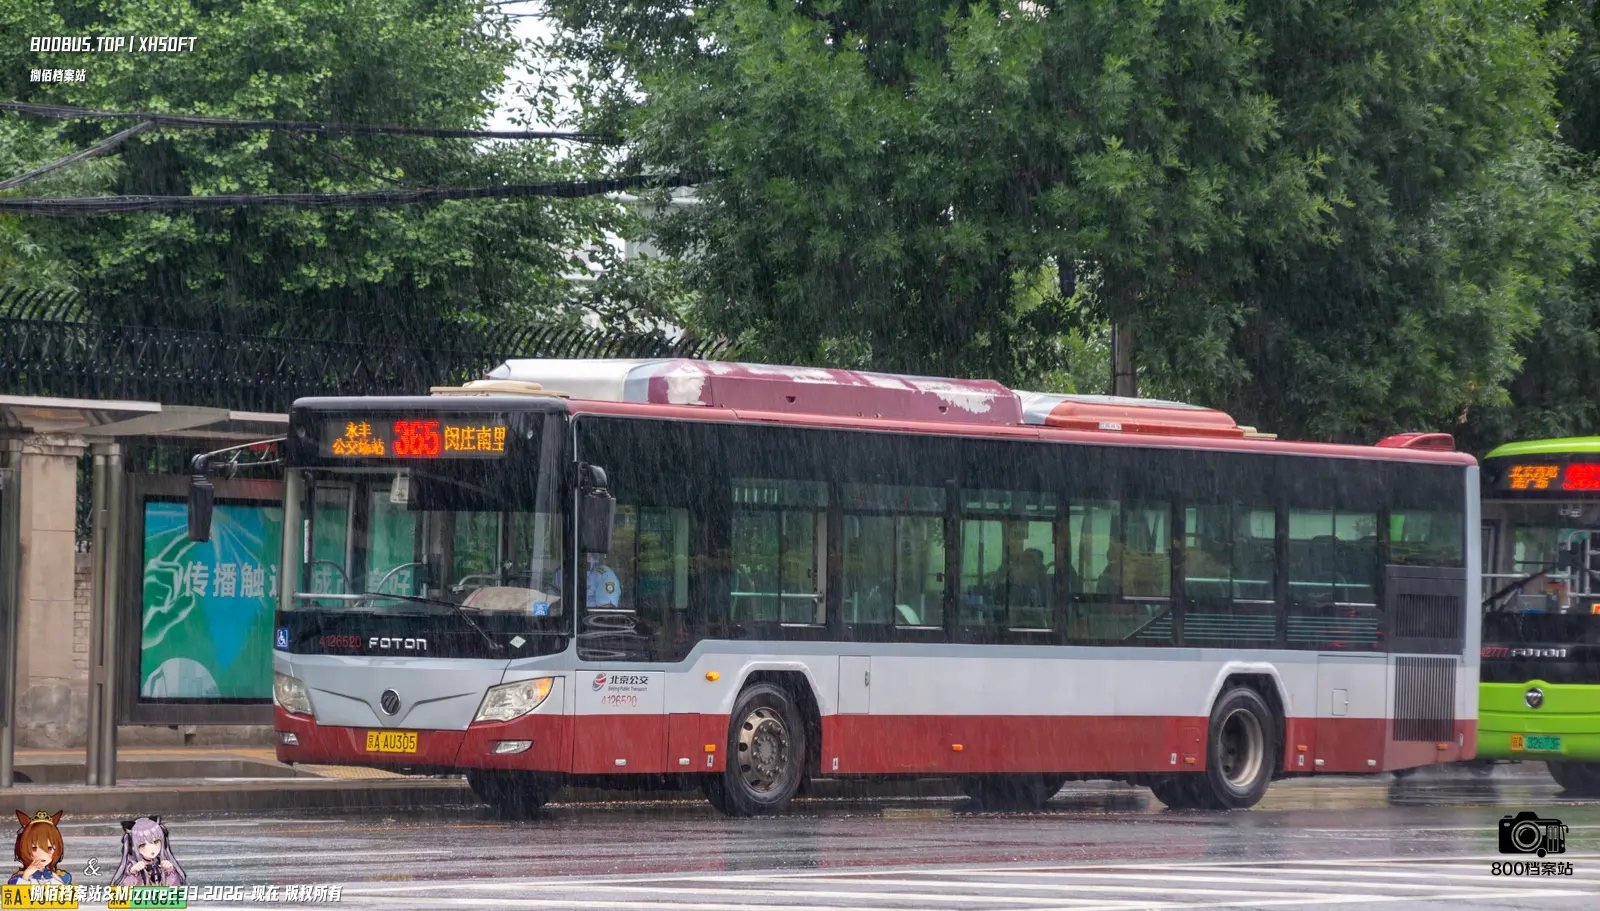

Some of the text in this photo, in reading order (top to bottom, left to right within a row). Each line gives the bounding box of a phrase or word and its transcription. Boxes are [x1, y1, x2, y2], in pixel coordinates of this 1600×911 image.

[344, 421, 372, 441] 永丰
[393, 421, 441, 456] 365
[443, 425, 506, 451] 闵庄南里
[332, 437, 385, 456] 公交场站
[319, 635, 362, 649] 4126520
[368, 637, 427, 650] FOTON
[609, 675, 649, 685] 北京公交
